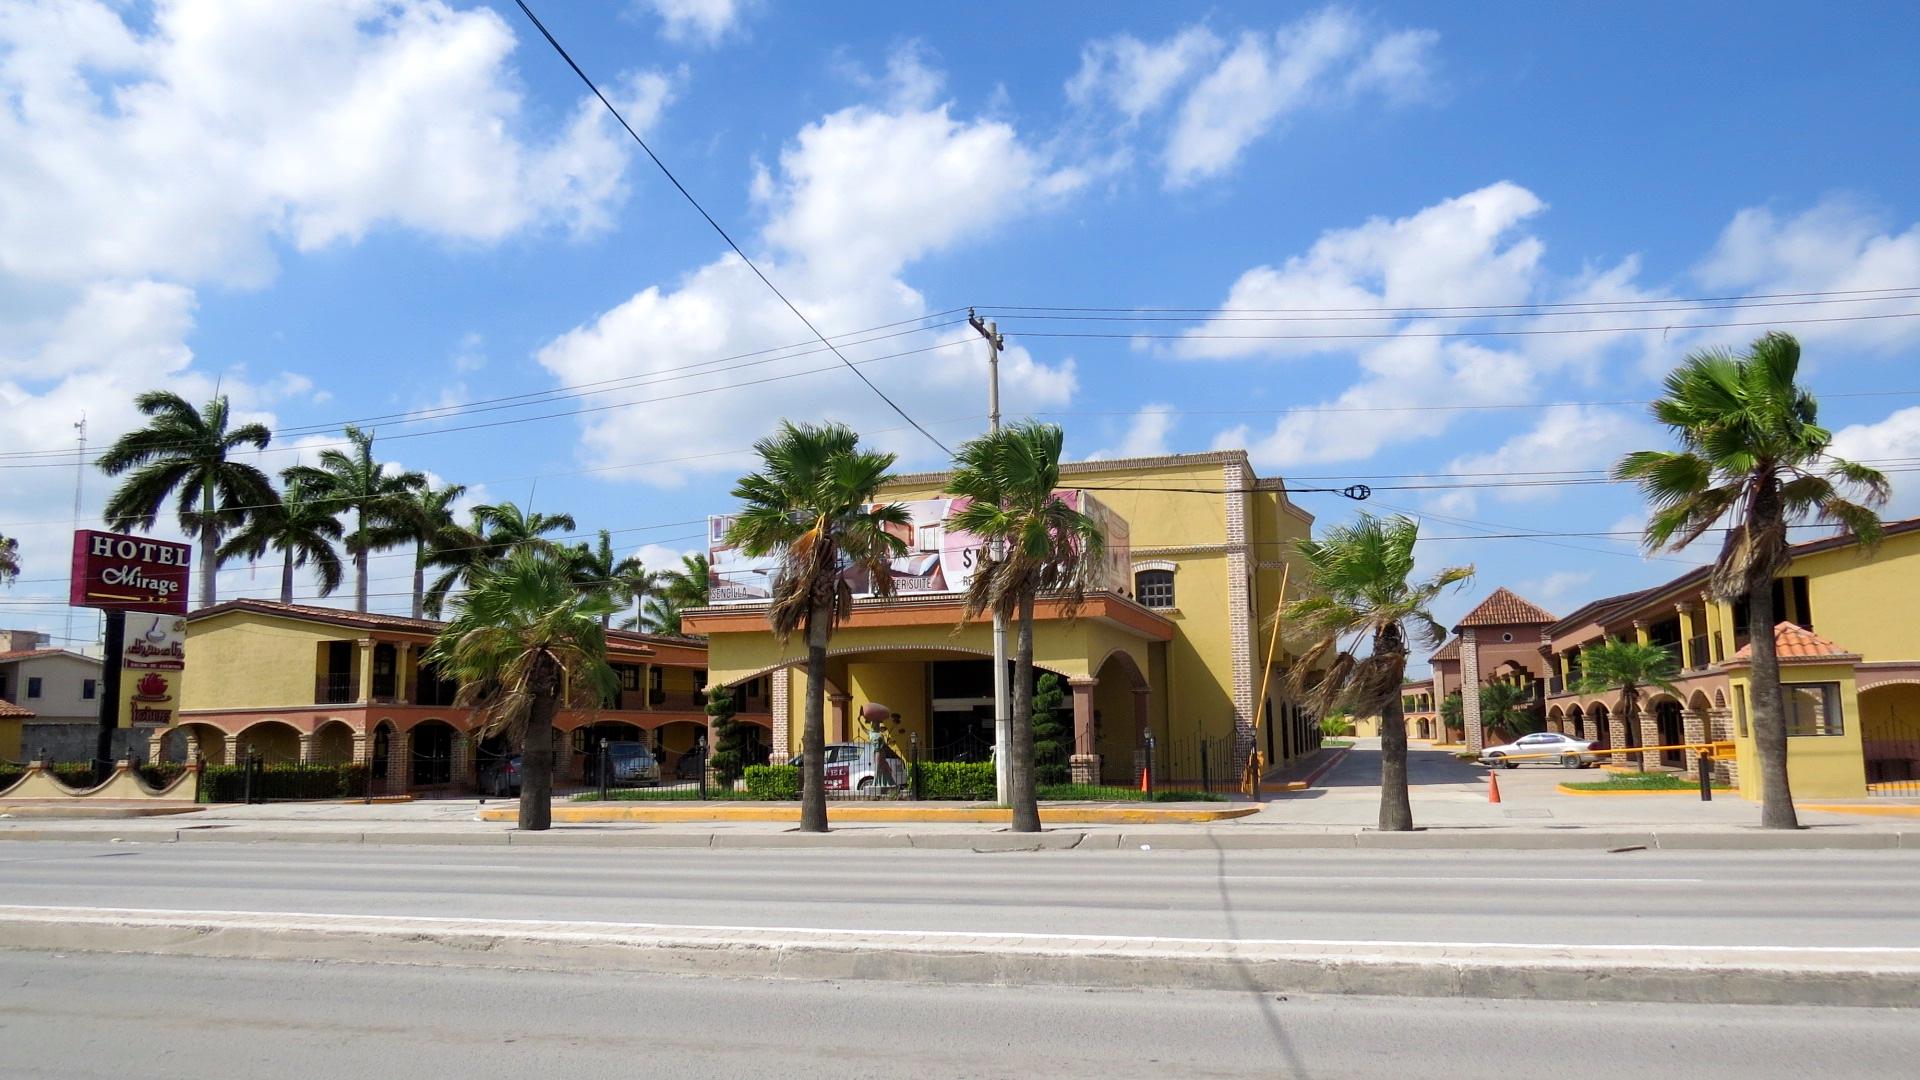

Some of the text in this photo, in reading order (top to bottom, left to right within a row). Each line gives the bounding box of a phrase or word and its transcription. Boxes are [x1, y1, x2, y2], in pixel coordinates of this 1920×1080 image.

[91, 536, 190, 567] HOTEL
[102, 565, 179, 596] Mirage
[908, 578, 932, 590] SUITE
